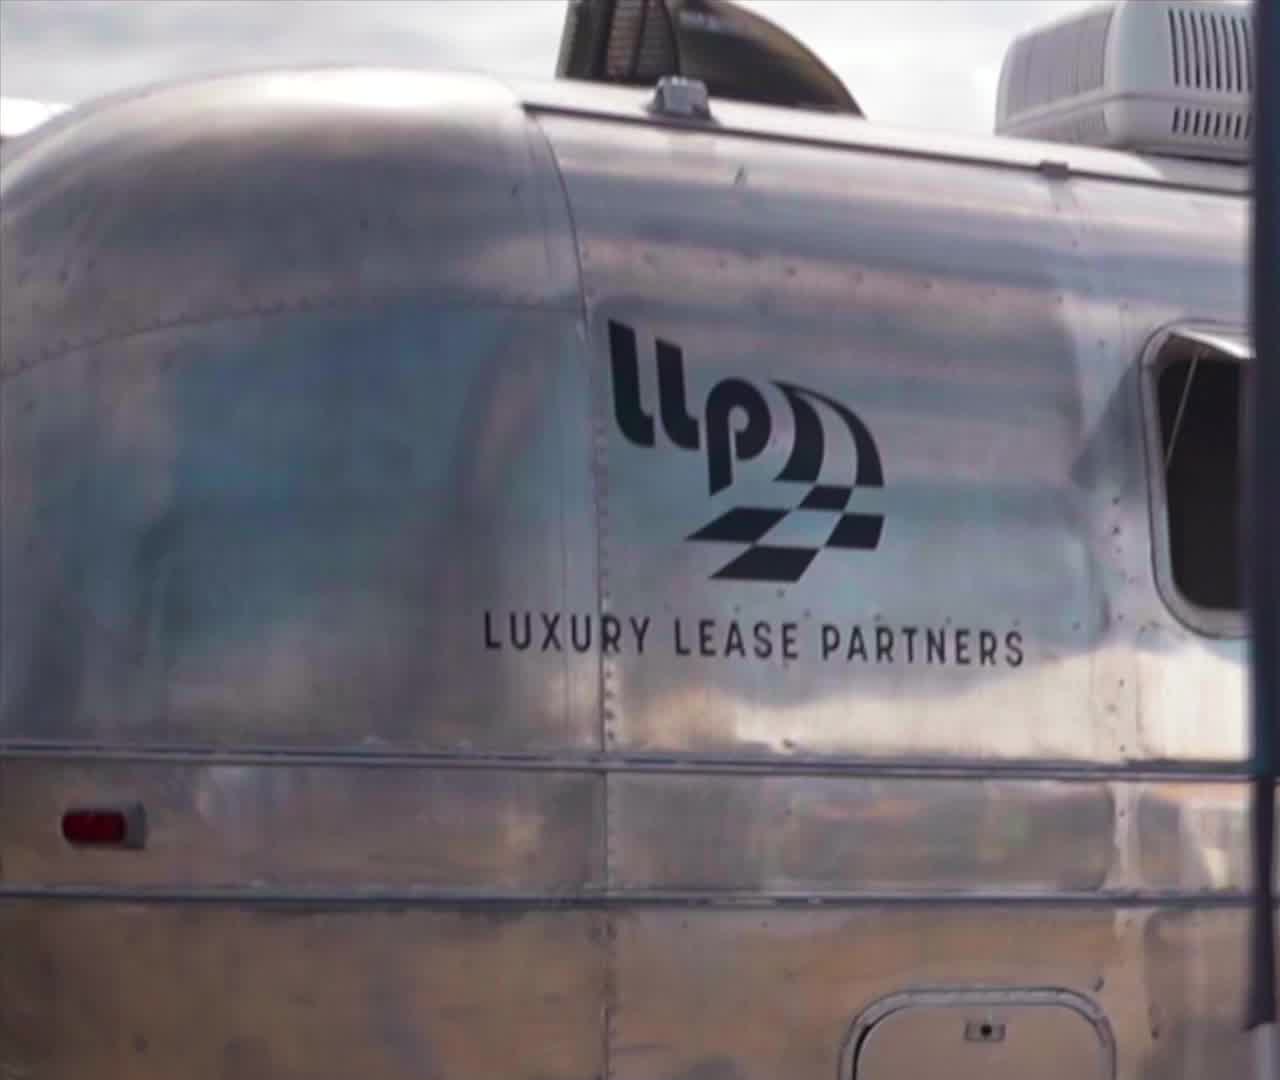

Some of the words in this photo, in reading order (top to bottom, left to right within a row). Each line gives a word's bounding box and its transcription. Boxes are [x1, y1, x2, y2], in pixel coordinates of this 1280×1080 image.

[484, 612, 651, 657] LUXURY
[674, 618, 799, 660] LEASE
[821, 624, 1025, 668] PARTNERS
